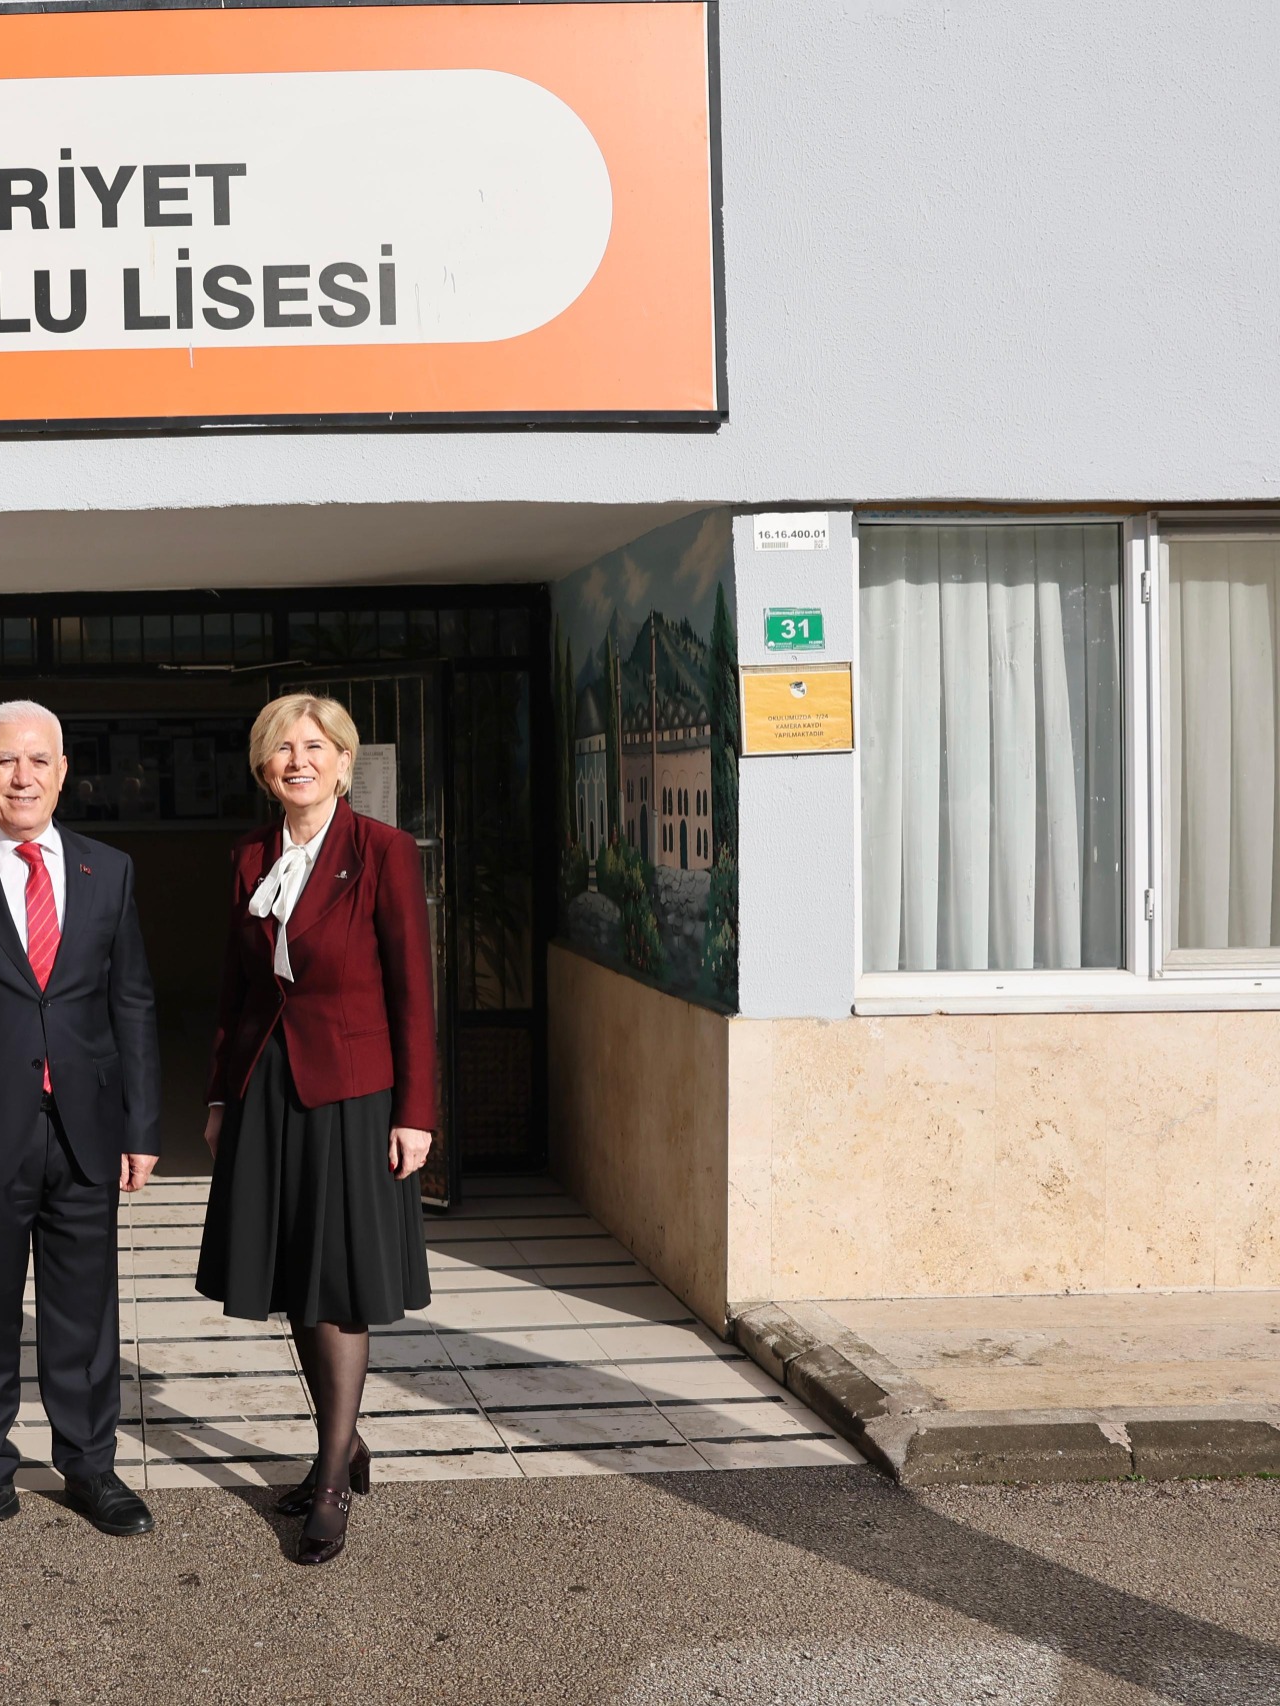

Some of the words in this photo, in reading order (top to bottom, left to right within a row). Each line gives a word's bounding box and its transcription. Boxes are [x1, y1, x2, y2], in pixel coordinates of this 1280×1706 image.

[123, 244, 397, 331] LİSESİ
[758, 529, 826, 539] 16.16.400.01
[781, 618, 809, 639] 31
[767, 714, 812, 722] OKULUMUZDA
[776, 722, 802, 730] KAMERA
[774, 730, 824, 738] YAPILMAKTADIR
